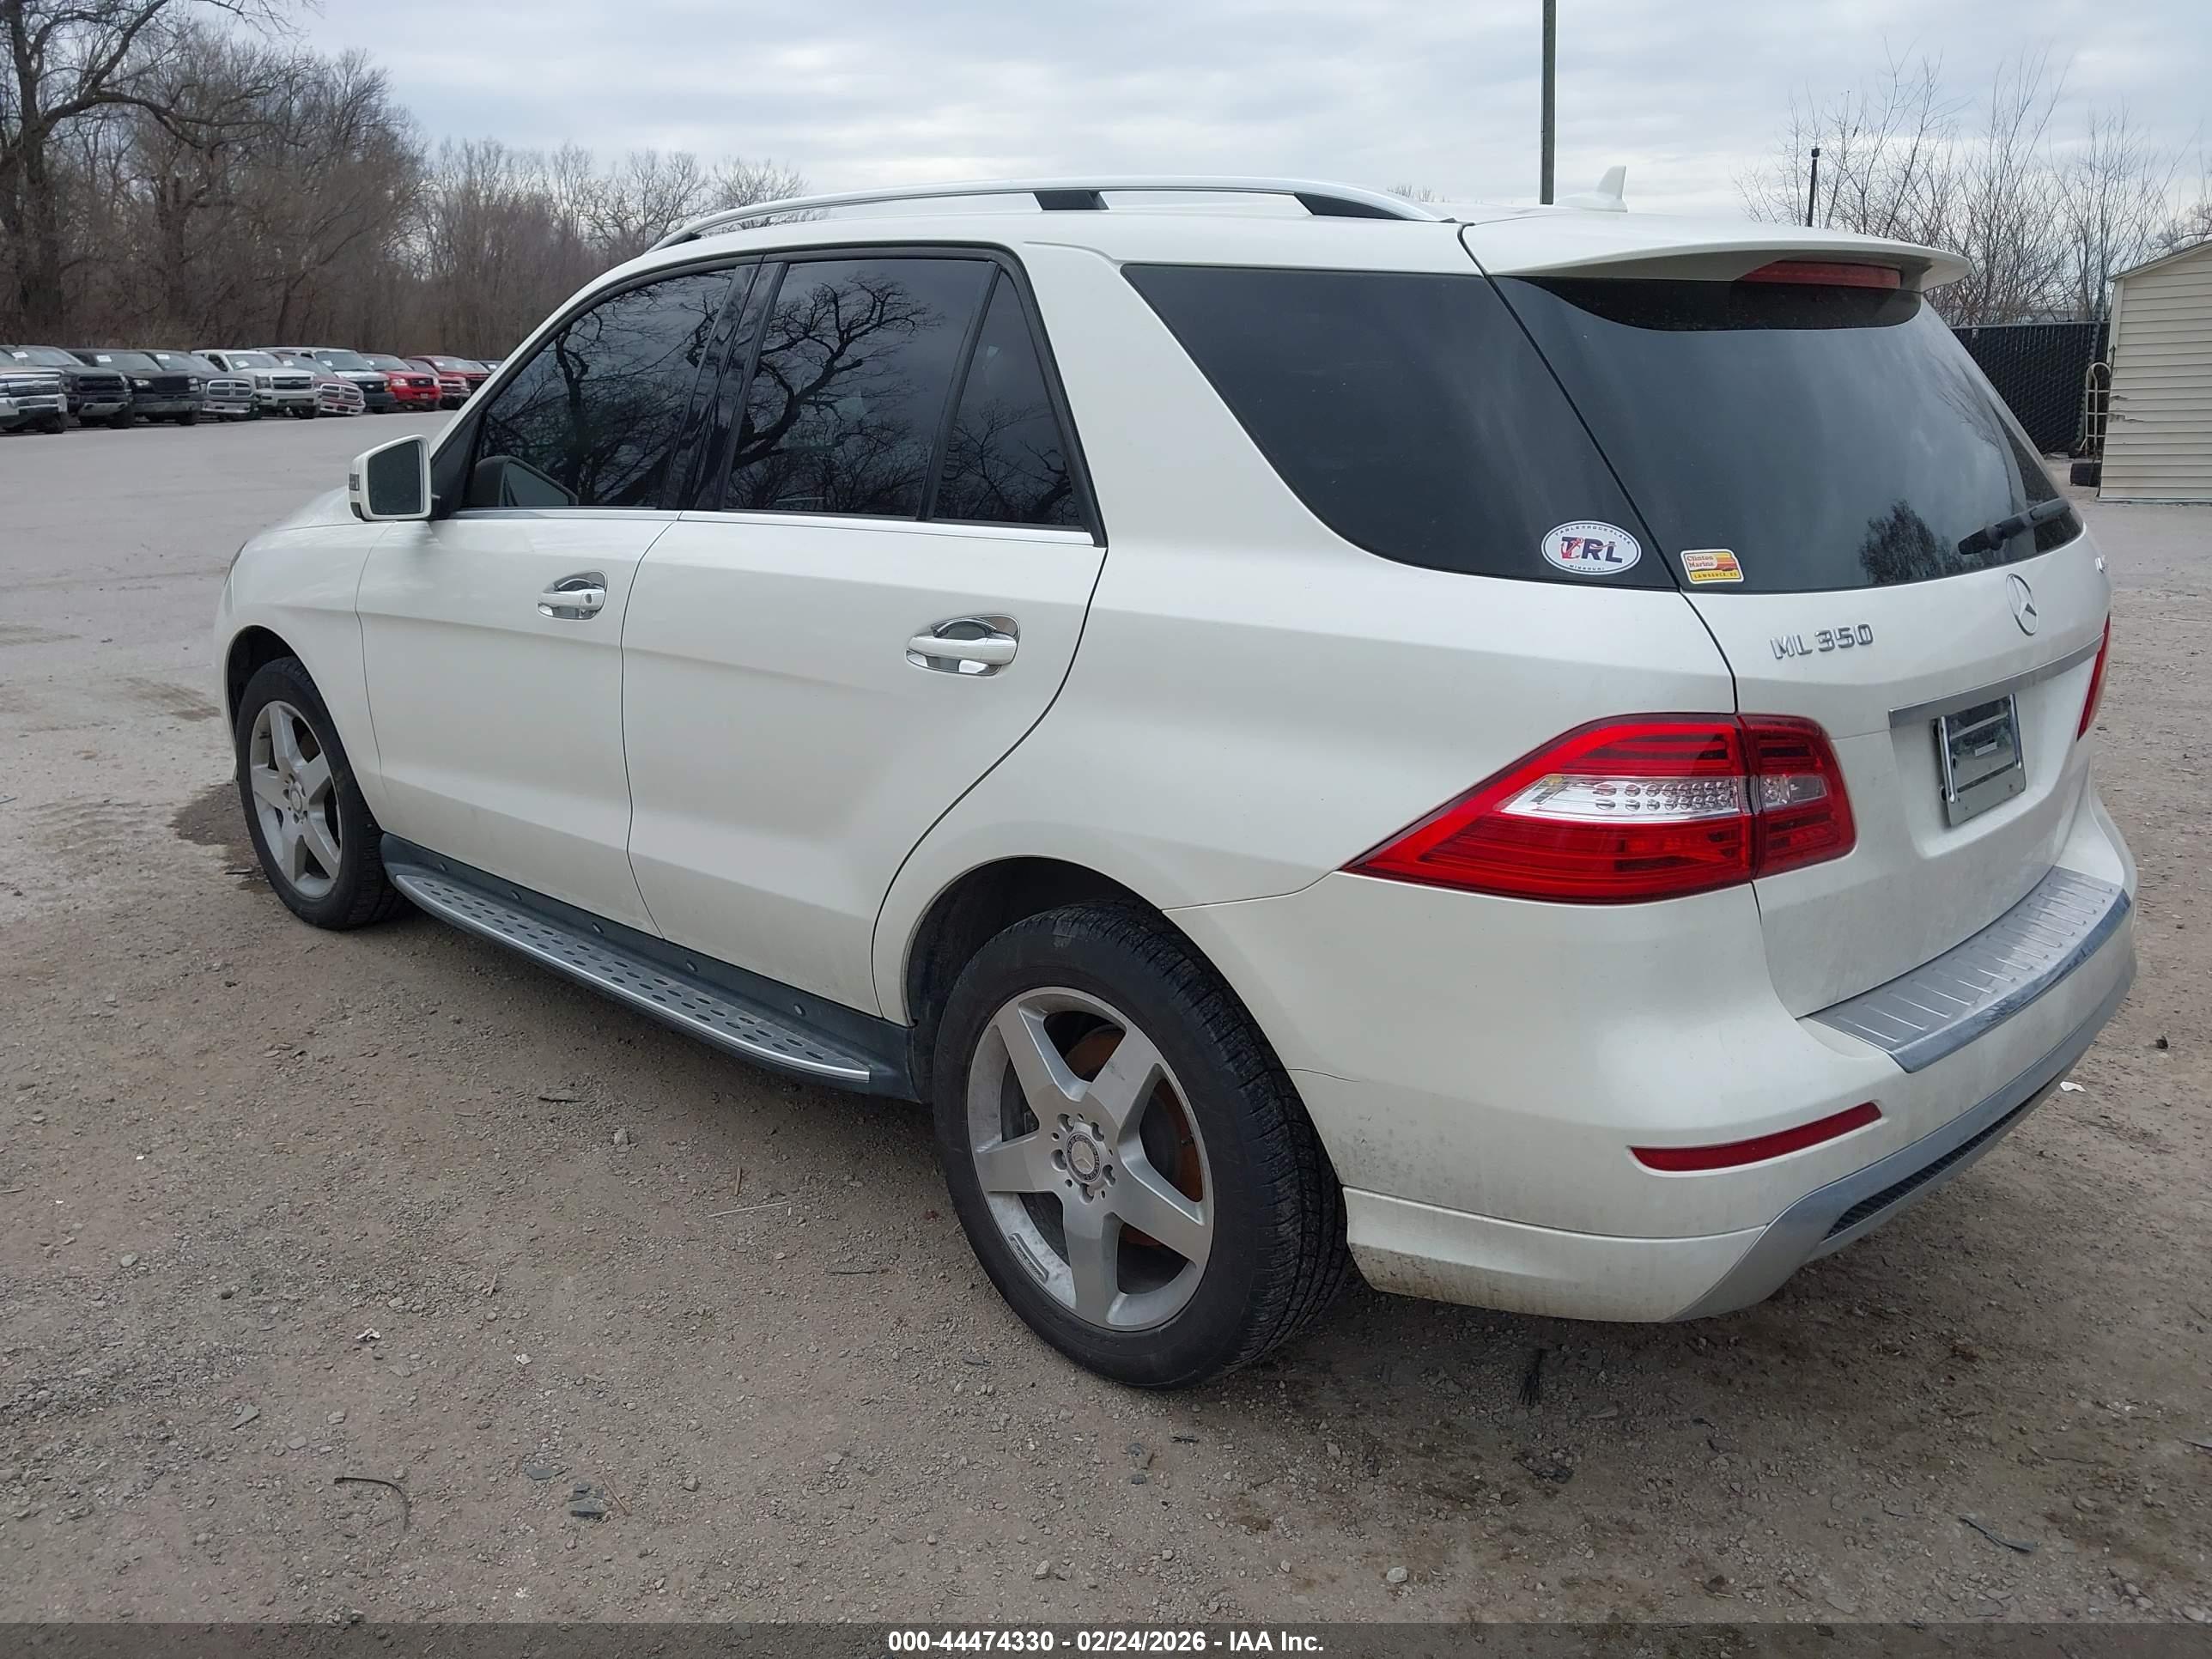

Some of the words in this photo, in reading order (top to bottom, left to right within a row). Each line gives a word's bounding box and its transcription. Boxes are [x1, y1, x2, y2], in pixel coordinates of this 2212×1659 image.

[1560, 536, 1623, 563] TRL
[1770, 635, 1813, 660] ML
[1814, 623, 1874, 653] 350
